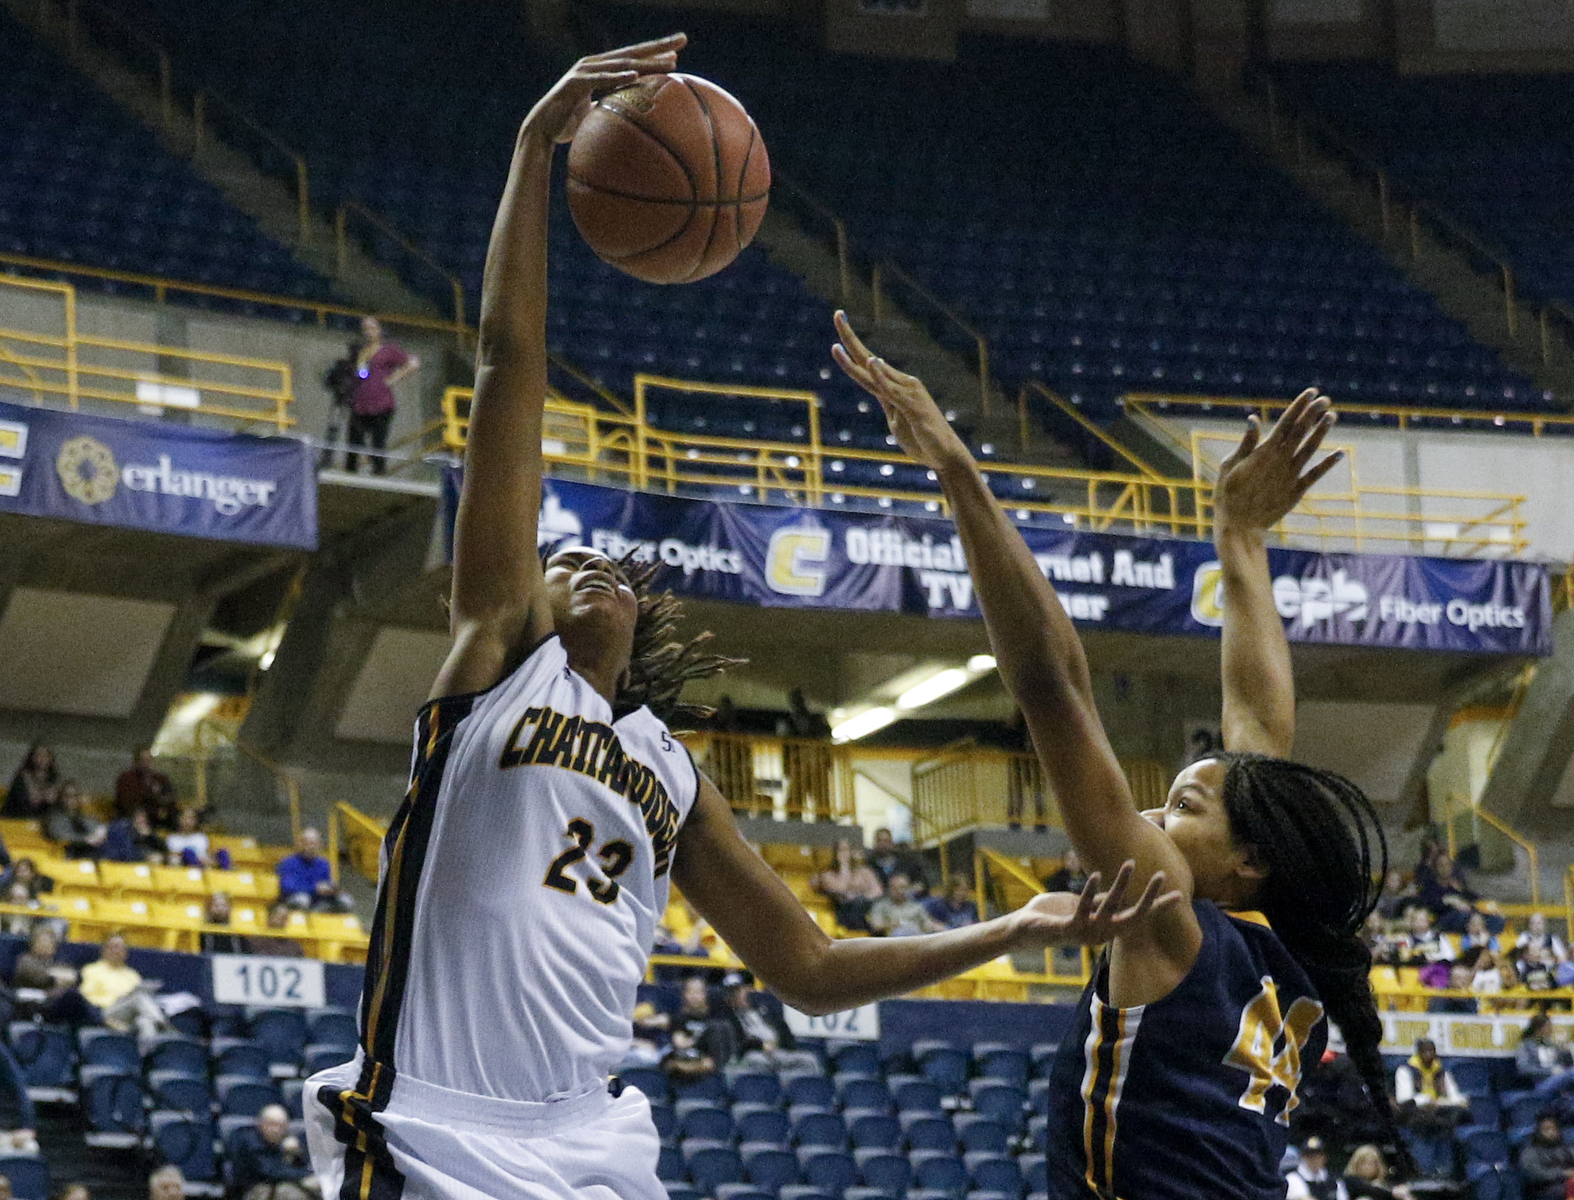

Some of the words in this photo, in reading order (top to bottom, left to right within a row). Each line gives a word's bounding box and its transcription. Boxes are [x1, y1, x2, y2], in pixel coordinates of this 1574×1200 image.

[122, 454, 275, 516] erlanger
[592, 529, 655, 564] Fiber
[660, 538, 742, 575] Optics
[846, 527, 965, 571] Official
[1034, 552, 1103, 584] rnet
[1111, 550, 1175, 590] And
[920, 573, 973, 610] TV
[1272, 570, 1367, 629] epb
[1380, 597, 1441, 625] Fiber
[1446, 600, 1524, 632] Optics
[542, 816, 635, 905] 23
[238, 964, 302, 998] 102
[1221, 974, 1324, 1128] 44
